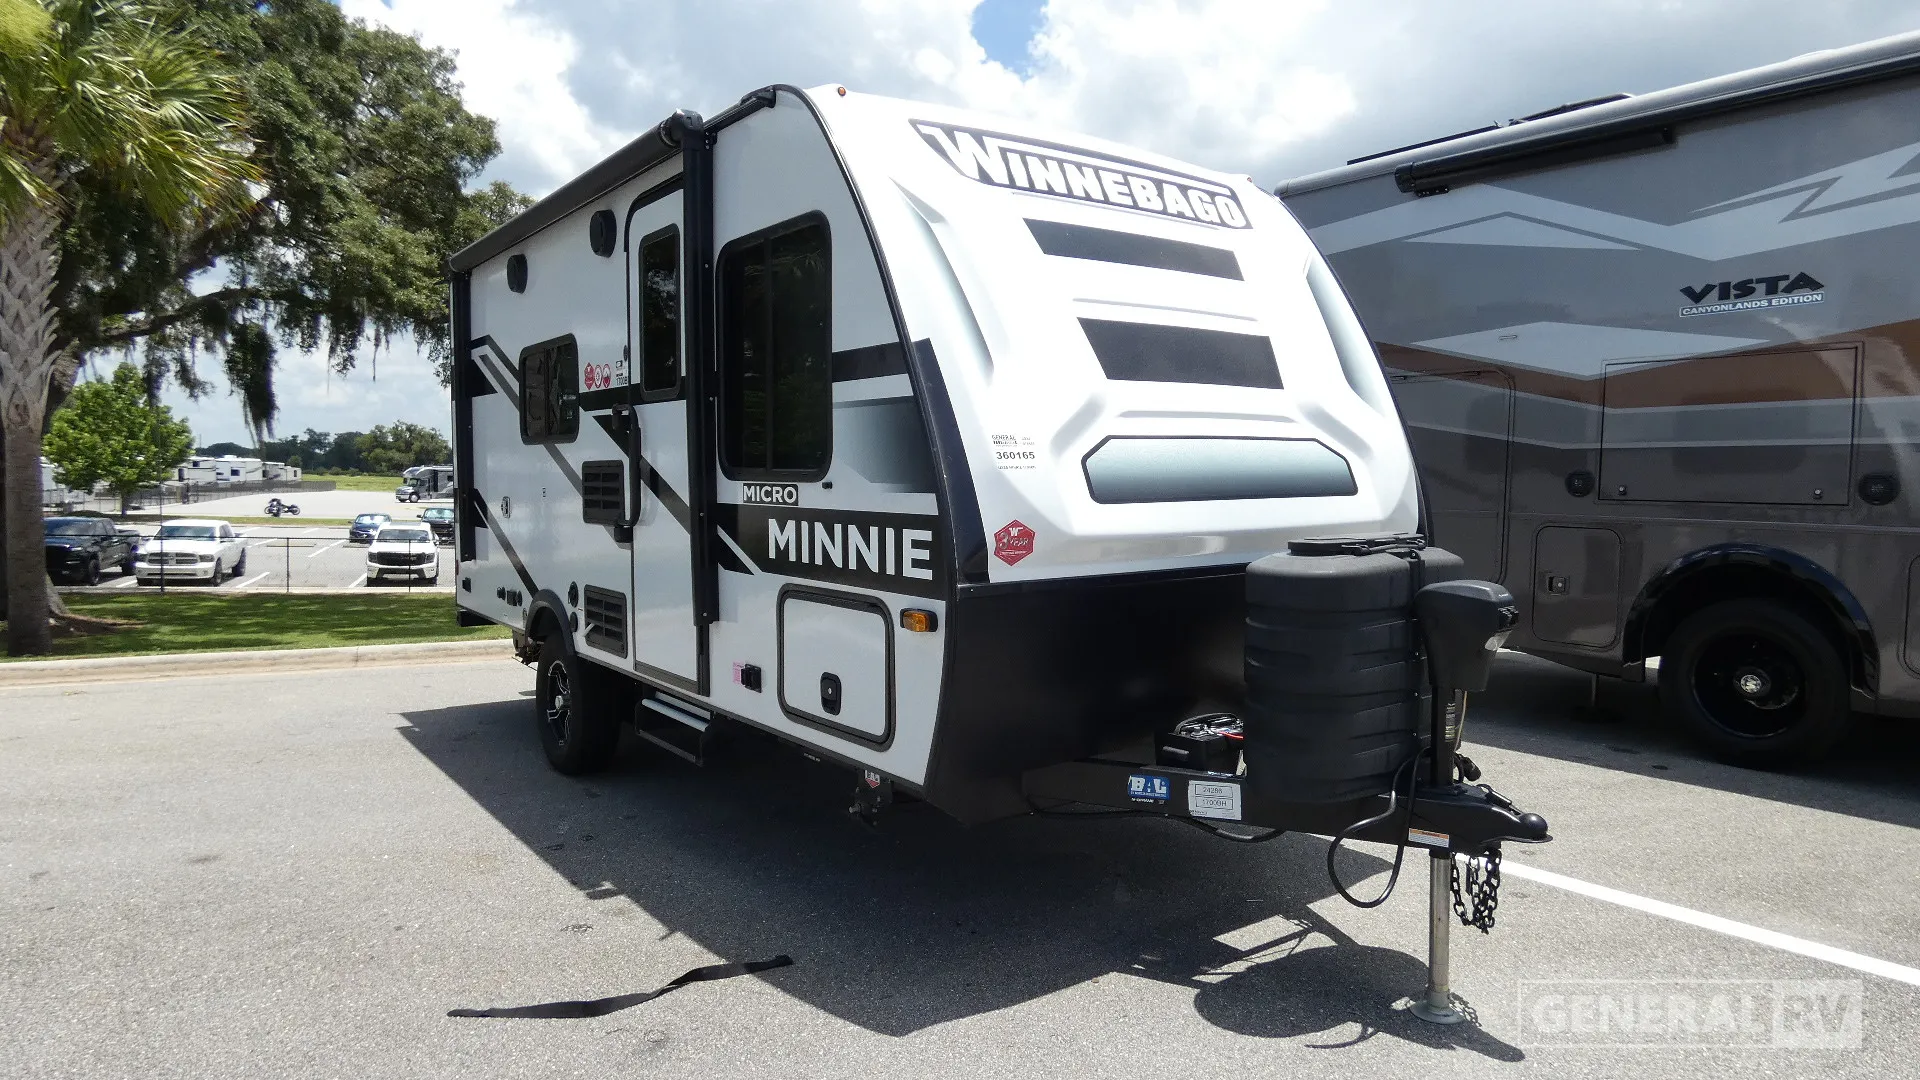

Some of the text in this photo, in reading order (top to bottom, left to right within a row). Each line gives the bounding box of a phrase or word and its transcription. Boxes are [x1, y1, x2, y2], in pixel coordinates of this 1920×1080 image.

[915, 123, 1247, 228] WINNEBAGO
[1679, 271, 1825, 305] VISTA
[1682, 293, 1822, 316] CANYONLANDS EDITION
[996, 451, 1036, 460] 360165
[743, 485, 797, 504] MICRO
[768, 518, 933, 581] MINNIE
